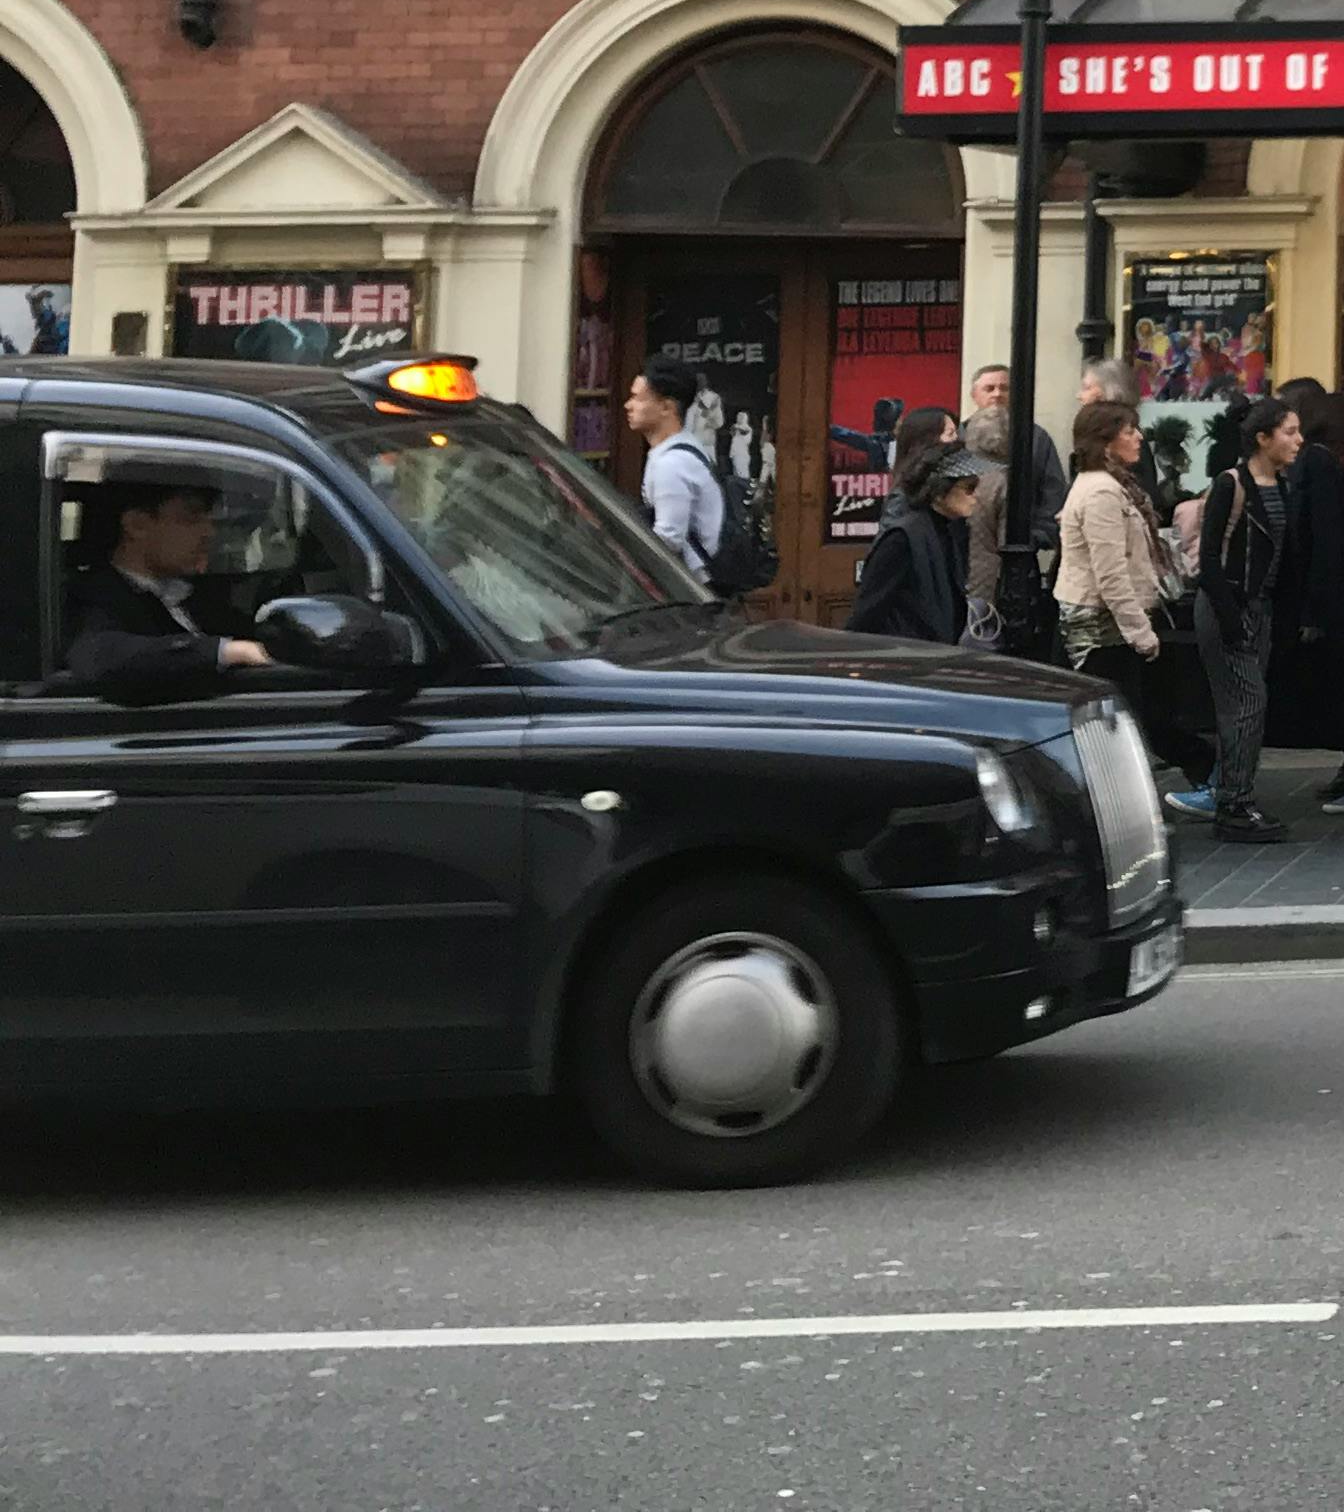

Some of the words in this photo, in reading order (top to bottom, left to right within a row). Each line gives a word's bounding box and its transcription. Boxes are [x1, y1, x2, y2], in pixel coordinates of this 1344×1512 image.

[917, 58, 992, 98] ABC
[1059, 55, 1171, 95] SHE'S
[1194, 53, 1264, 92] OUT
[1285, 53, 1328, 91] OF
[189, 284, 410, 326] THRILLER
[333, 324, 407, 359] Live
[661, 342, 765, 364] PEACE
[832, 496, 876, 517] Live
